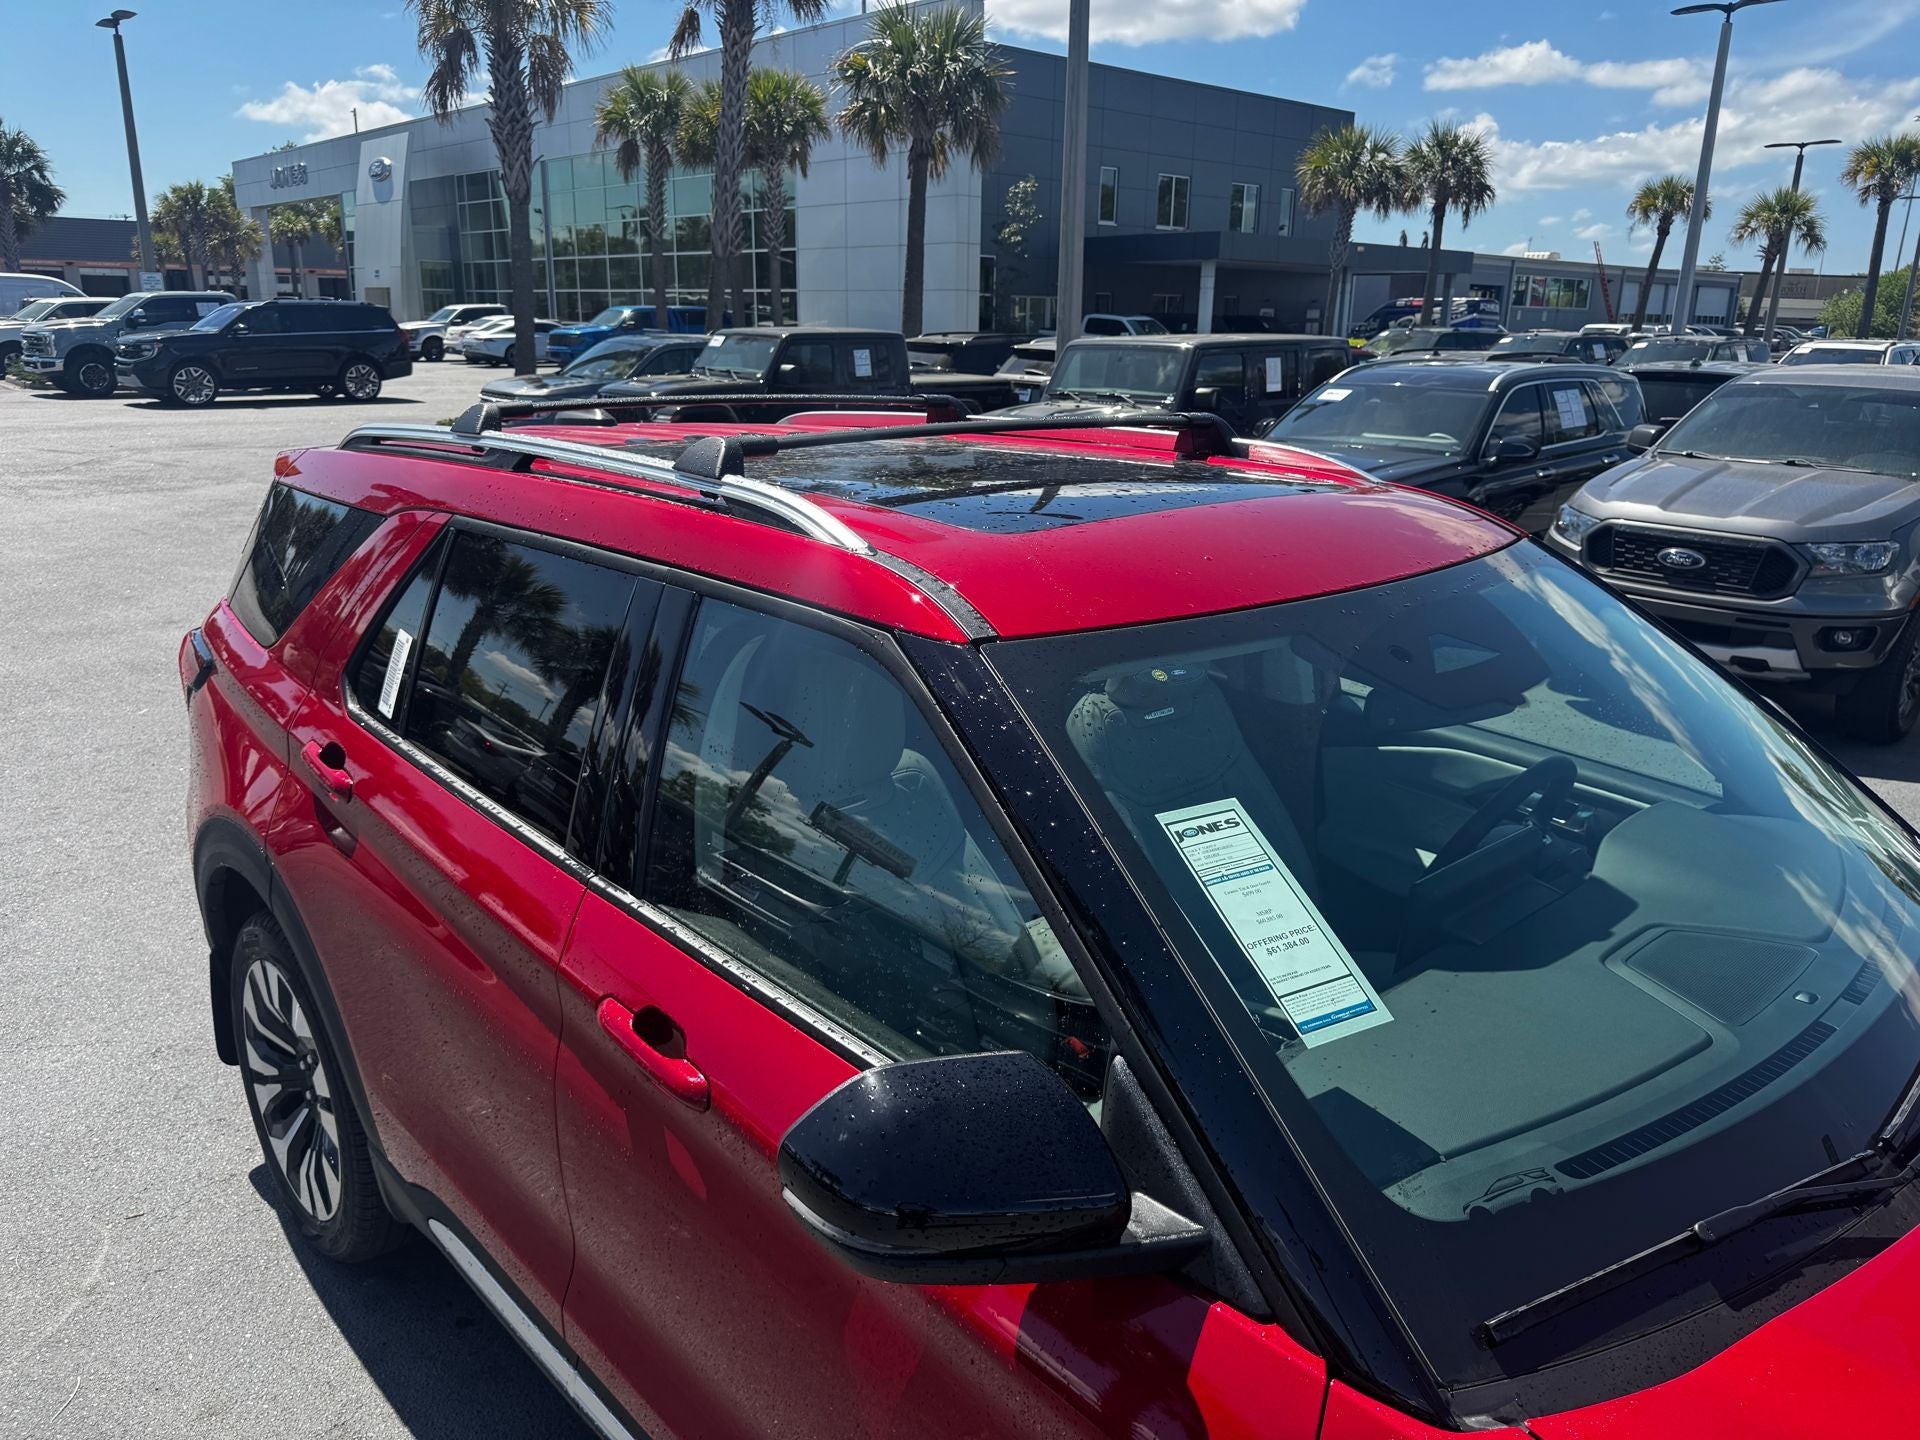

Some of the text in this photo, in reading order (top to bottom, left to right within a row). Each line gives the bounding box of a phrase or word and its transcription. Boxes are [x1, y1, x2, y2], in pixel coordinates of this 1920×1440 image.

[271, 163, 308, 189] JONES
[1174, 817, 1240, 843] JONES
[1246, 924, 1317, 950] OFFERING PRICE:
[1265, 936, 1310, 956] $61,384.00
